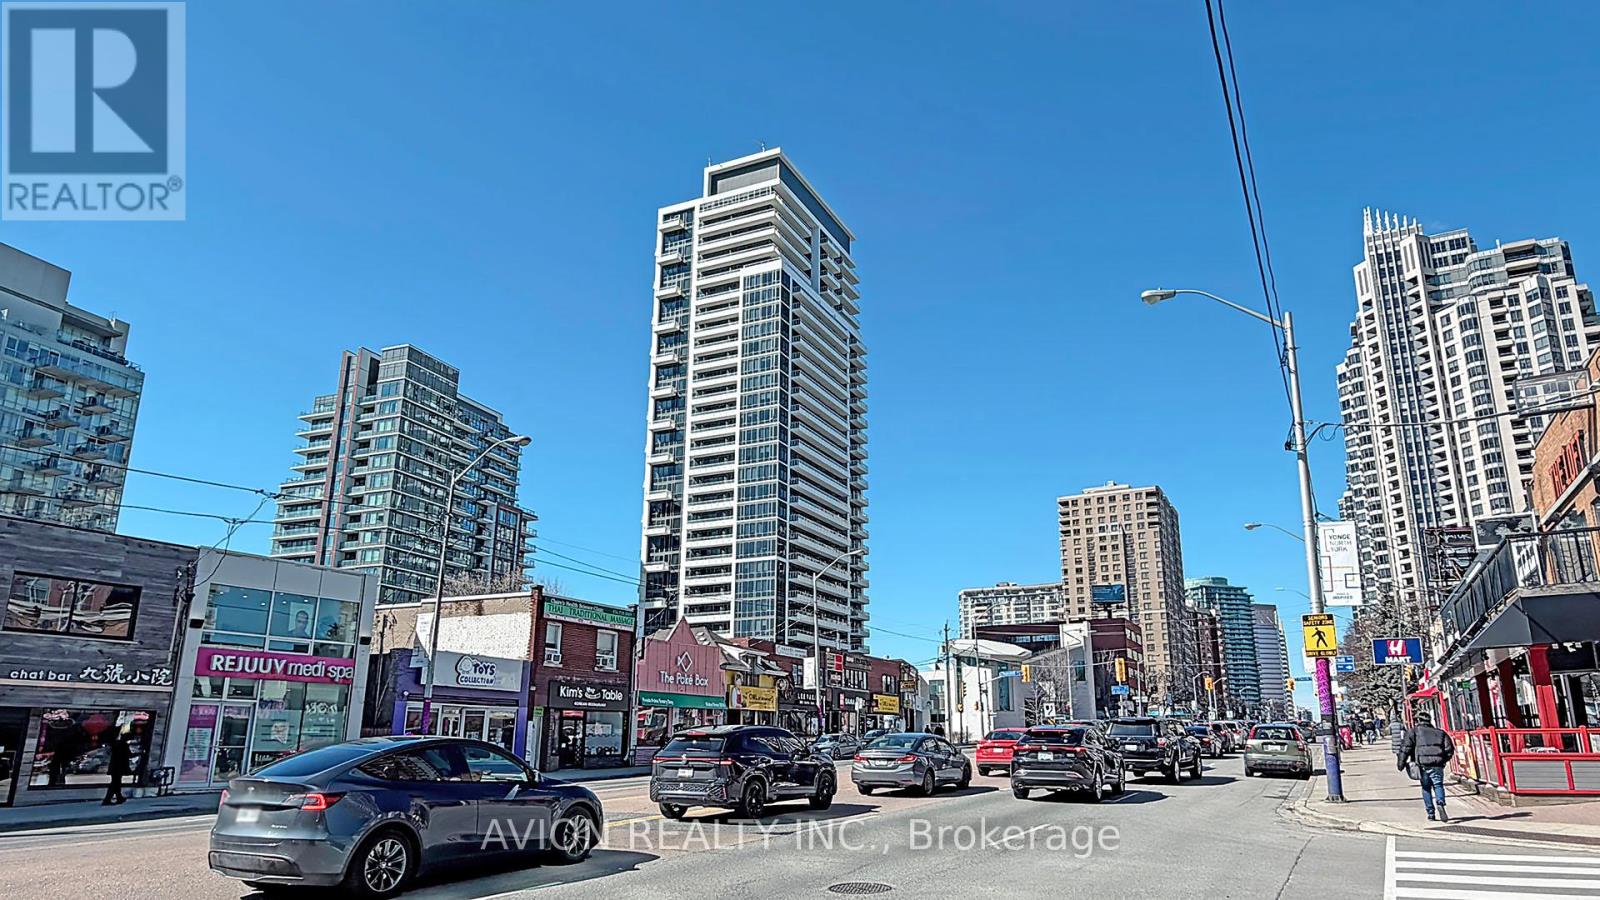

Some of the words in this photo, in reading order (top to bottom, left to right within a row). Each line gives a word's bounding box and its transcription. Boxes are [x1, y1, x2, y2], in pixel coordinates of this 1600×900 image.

[548, 603, 564, 613] THAI
[569, 607, 607, 621] TRADITIONAL
[610, 615, 634, 626] MASSAGE
[10, 669, 43, 679] chat
[47, 671, 71, 681] bar
[211, 654, 287, 674] REJUUV
[288, 661, 326, 677] medi
[327, 666, 354, 681] spa
[460, 675, 495, 684] COLLECTION
[660, 671, 674, 684] The
[695, 674, 709, 686] Box
[560, 685, 583, 698] Kim's
[601, 689, 623, 701] Table
